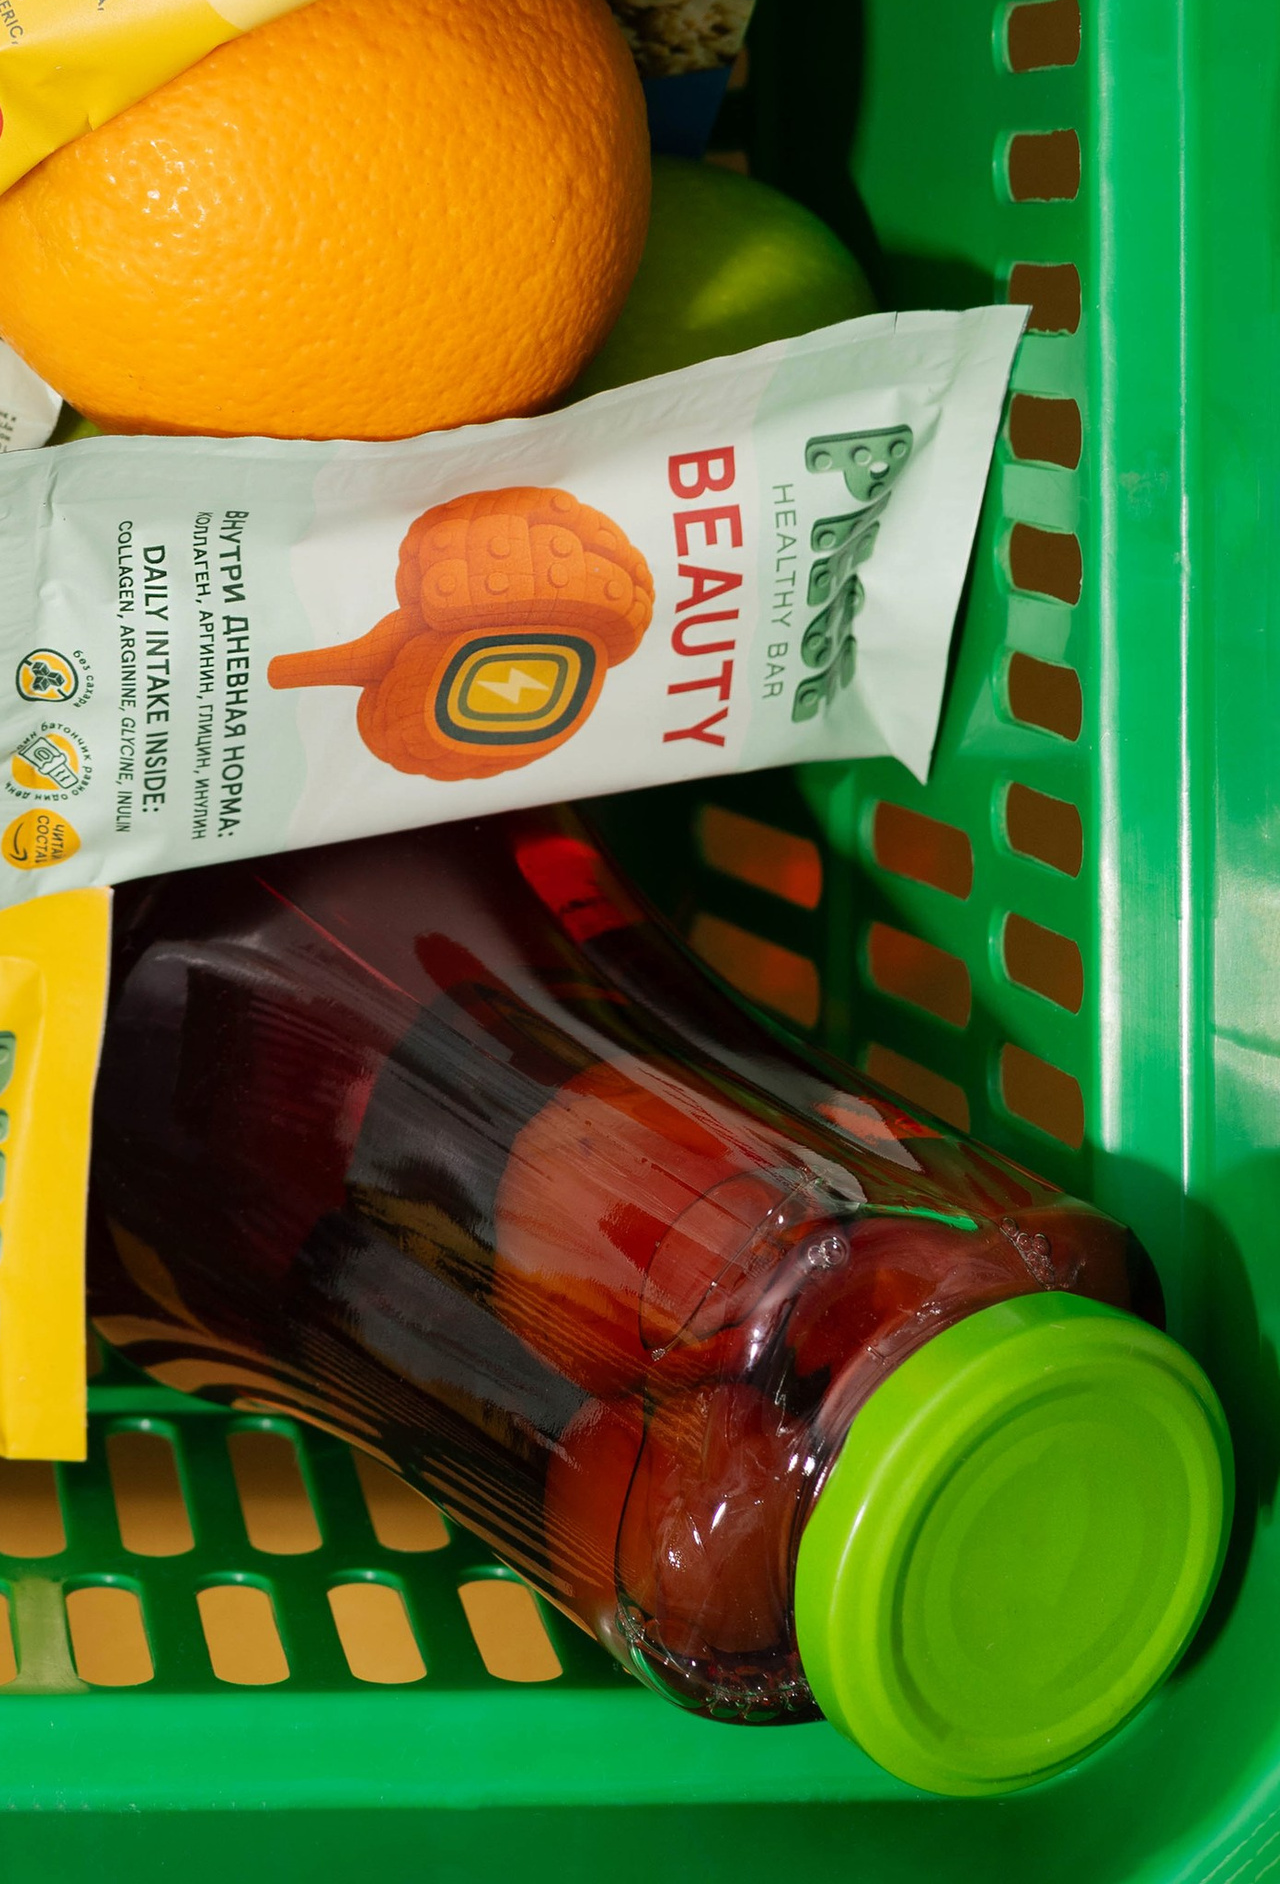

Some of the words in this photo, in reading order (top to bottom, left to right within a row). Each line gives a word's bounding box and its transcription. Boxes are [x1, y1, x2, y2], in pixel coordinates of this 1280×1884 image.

[117, 520, 134, 618] COLLAGEN,
[143, 545, 168, 621] DAILY
[193, 512, 213, 604] КОЛЛАГЕН,
[219, 511, 249, 603] ВНУТРИ
[663, 446, 743, 746] BEAUTY
[771, 483, 797, 627] HEALTHY
[119, 625, 136, 711] ARGININE,
[146, 631, 170, 724] INTAKE
[196, 610, 214, 699] АРГИНИН,
[222, 615, 249, 738] ДНЕВНАЯ
[762, 642, 789, 699] BAR
[116, 717, 136, 785] GLYCINE,
[142, 731, 168, 812] INSIDE:
[193, 704, 213, 774] ГЛИЦИН,
[116, 791, 132, 832] INULIN
[192, 778, 210, 840] ИНУЛИН
[218, 745, 245, 837] НОРМА:
